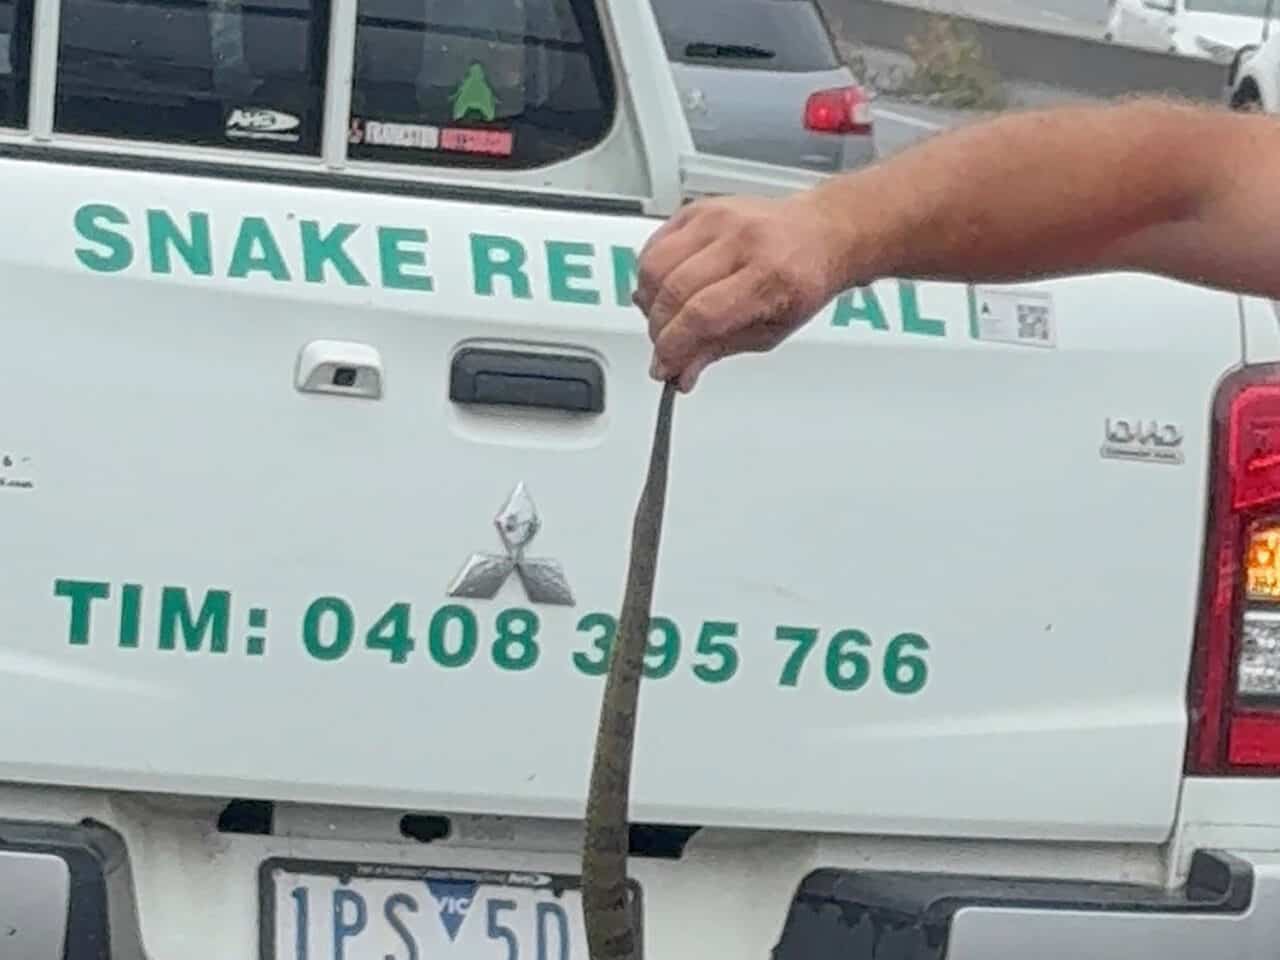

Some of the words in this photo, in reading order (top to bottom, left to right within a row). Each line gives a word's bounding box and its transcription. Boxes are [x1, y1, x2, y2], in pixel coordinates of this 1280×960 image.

[73, 204, 434, 292] SNAKE
[470, 232, 946, 338] REAL
[54, 578, 268, 657] TIM:
[302, 597, 540, 672] 0408
[572, 612, 738, 685] 395
[774, 626, 931, 695] 766
[437, 898, 471, 915] VIC
